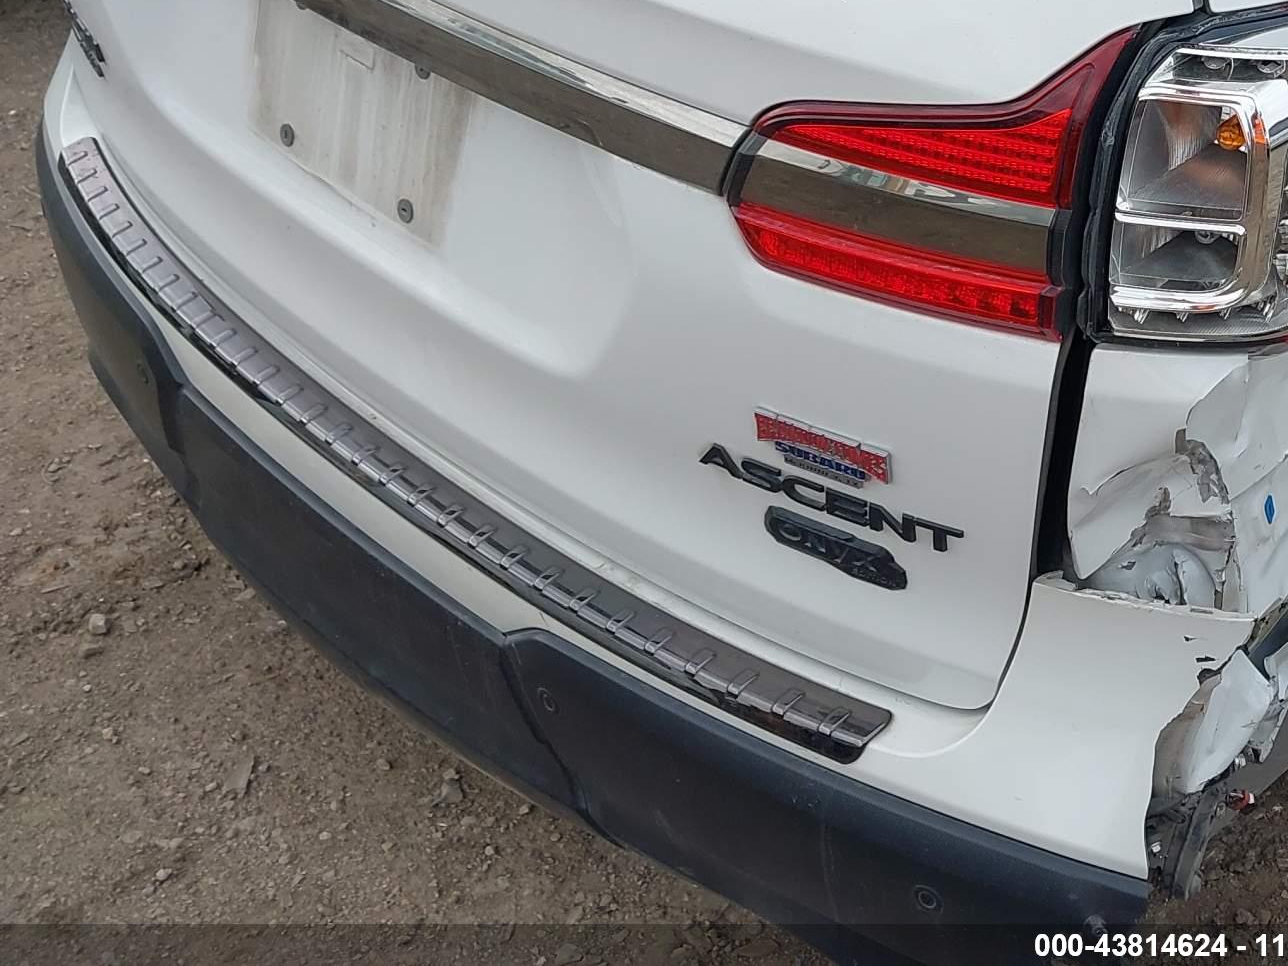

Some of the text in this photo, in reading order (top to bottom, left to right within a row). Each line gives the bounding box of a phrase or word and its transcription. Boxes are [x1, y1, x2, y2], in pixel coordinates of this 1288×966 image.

[774, 440, 866, 481] SUBARU
[699, 443, 965, 552] ASCENT
[778, 520, 881, 572] ONYX
